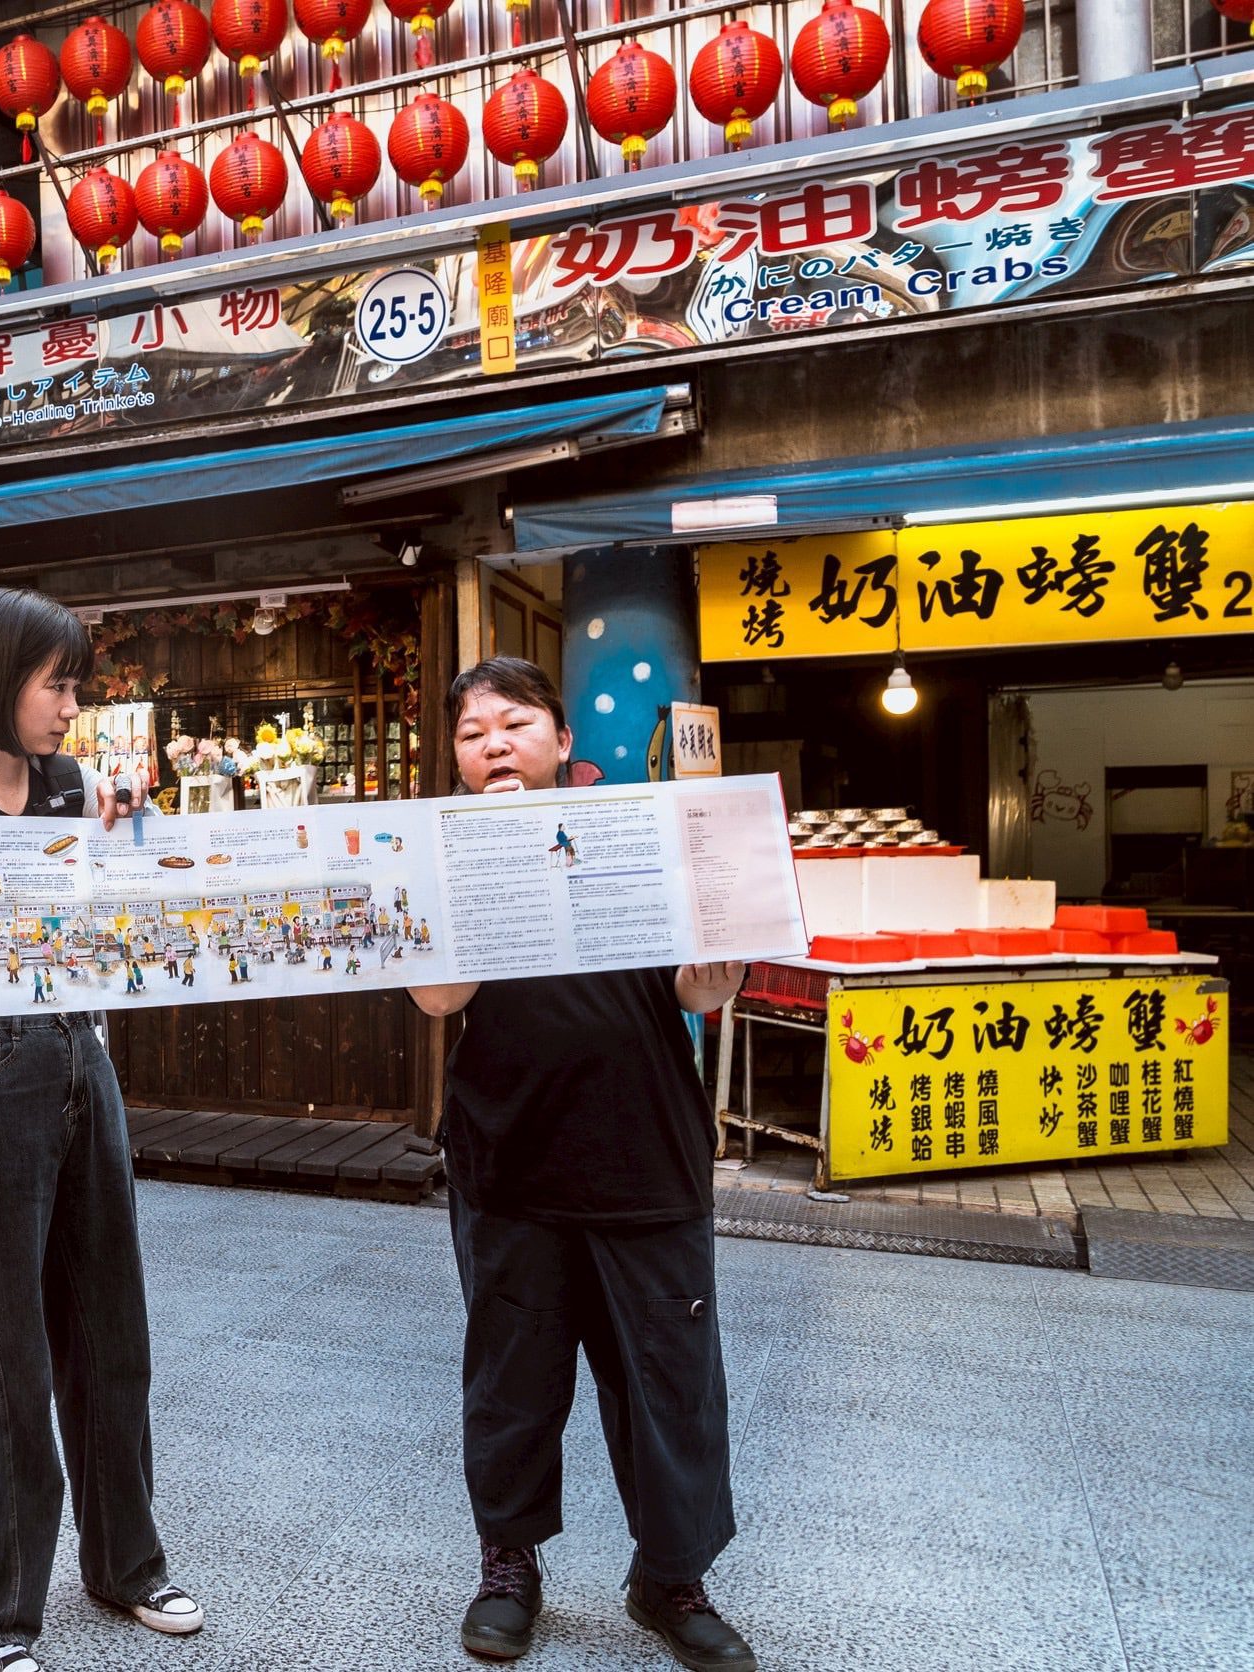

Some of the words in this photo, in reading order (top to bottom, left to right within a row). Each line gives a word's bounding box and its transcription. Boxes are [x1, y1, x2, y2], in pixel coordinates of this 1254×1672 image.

[550, 109, 1254, 288] 奶油螃蟹
[711, 217, 1085, 297] かにのバター焼き
[724, 284, 882, 323] Cream
[907, 256, 1069, 295] Crabs
[482, 239, 511, 361] 基隆廟口
[79, 390, 156, 416] Trinkets
[739, 550, 790, 648] 燒烤
[809, 522, 1210, 629] 奶油螃蟹
[1223, 570, 1253, 618] 2
[893, 988, 1167, 1061] 奶油螃蟹
[869, 1076, 896, 1153] 燒烤
[910, 1074, 933, 1162] 烤銀蛤
[943, 1071, 966, 1160] 烤蝦串
[977, 1068, 1000, 1157] 燒風螺
[1039, 1064, 1063, 1138] 快炒
[1076, 1062, 1098, 1149] 沙茶蟹
[1109, 1061, 1130, 1146] 咖哩蟹
[1141, 1060, 1162, 1143] 桂花蟹
[1173, 1057, 1194, 1140] 紅燒蟹
